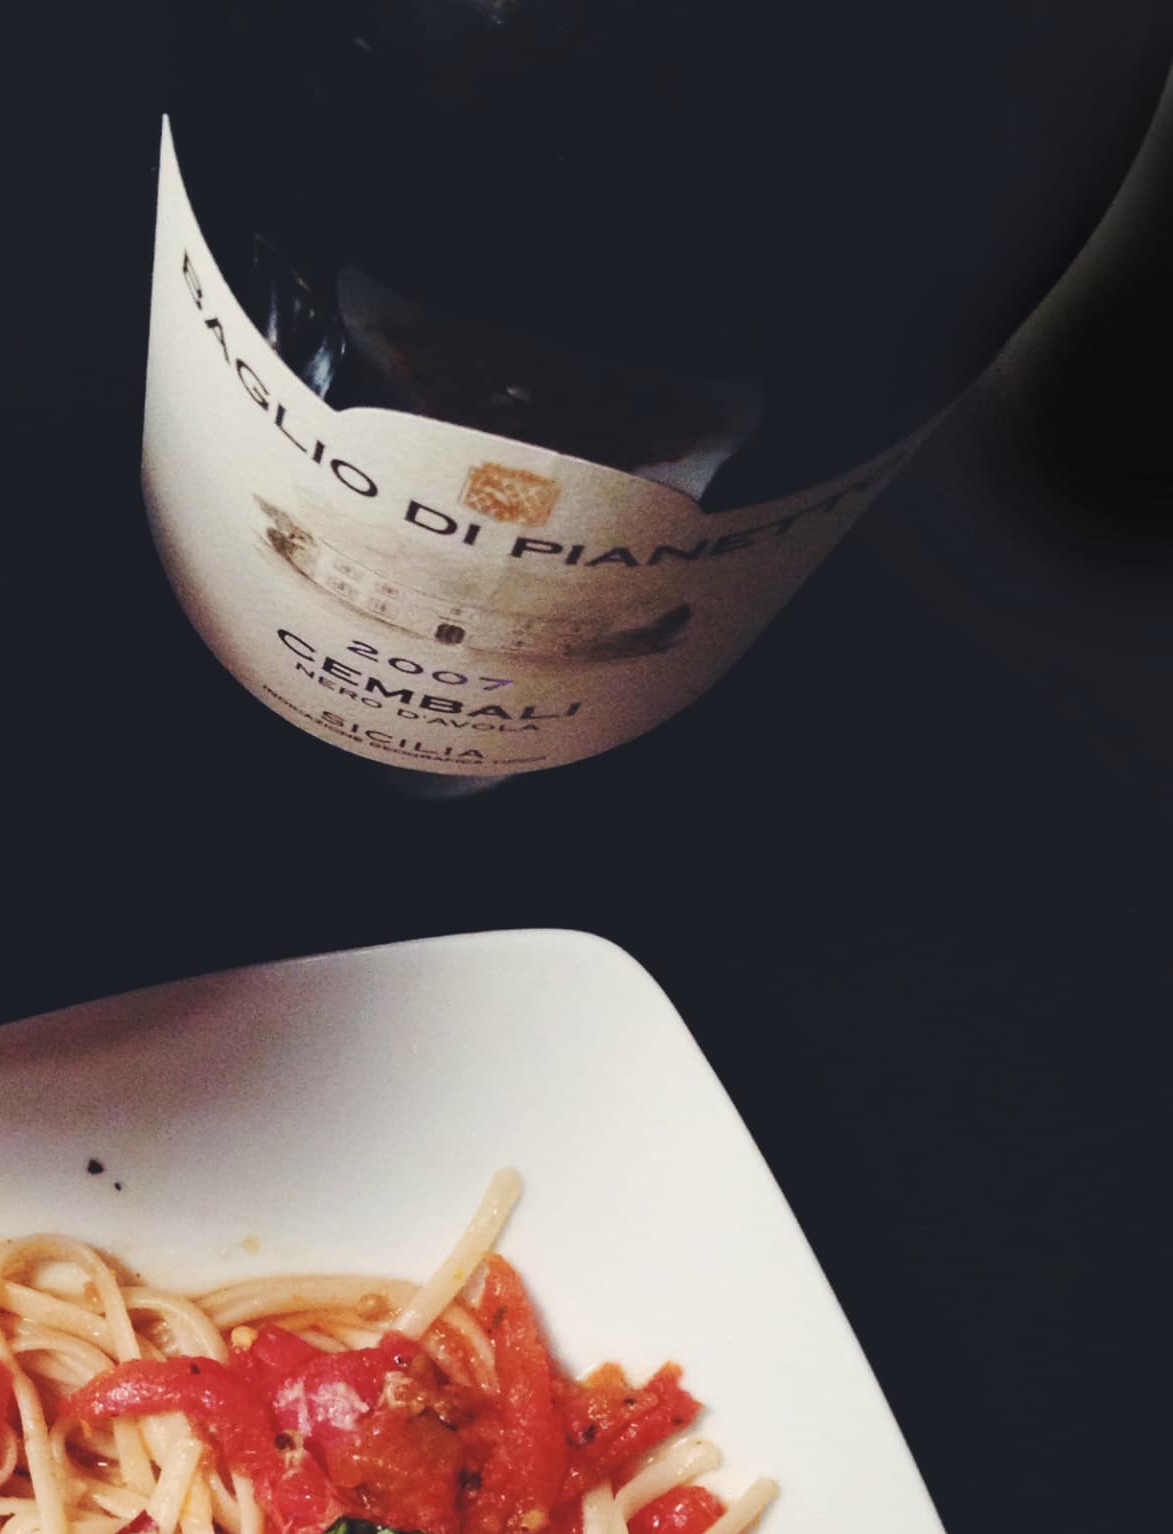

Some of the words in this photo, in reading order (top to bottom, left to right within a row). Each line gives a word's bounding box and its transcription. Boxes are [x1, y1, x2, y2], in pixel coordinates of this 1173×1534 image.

[182, 249, 379, 498] BAGLIO
[404, 500, 482, 547] DI
[276, 628, 583, 720] CEMBALI
[294, 662, 384, 709] NERO
[396, 708, 540, 732] D'AVOLA
[346, 639, 515, 691] 2007
[321, 710, 484, 759] SICILIA
